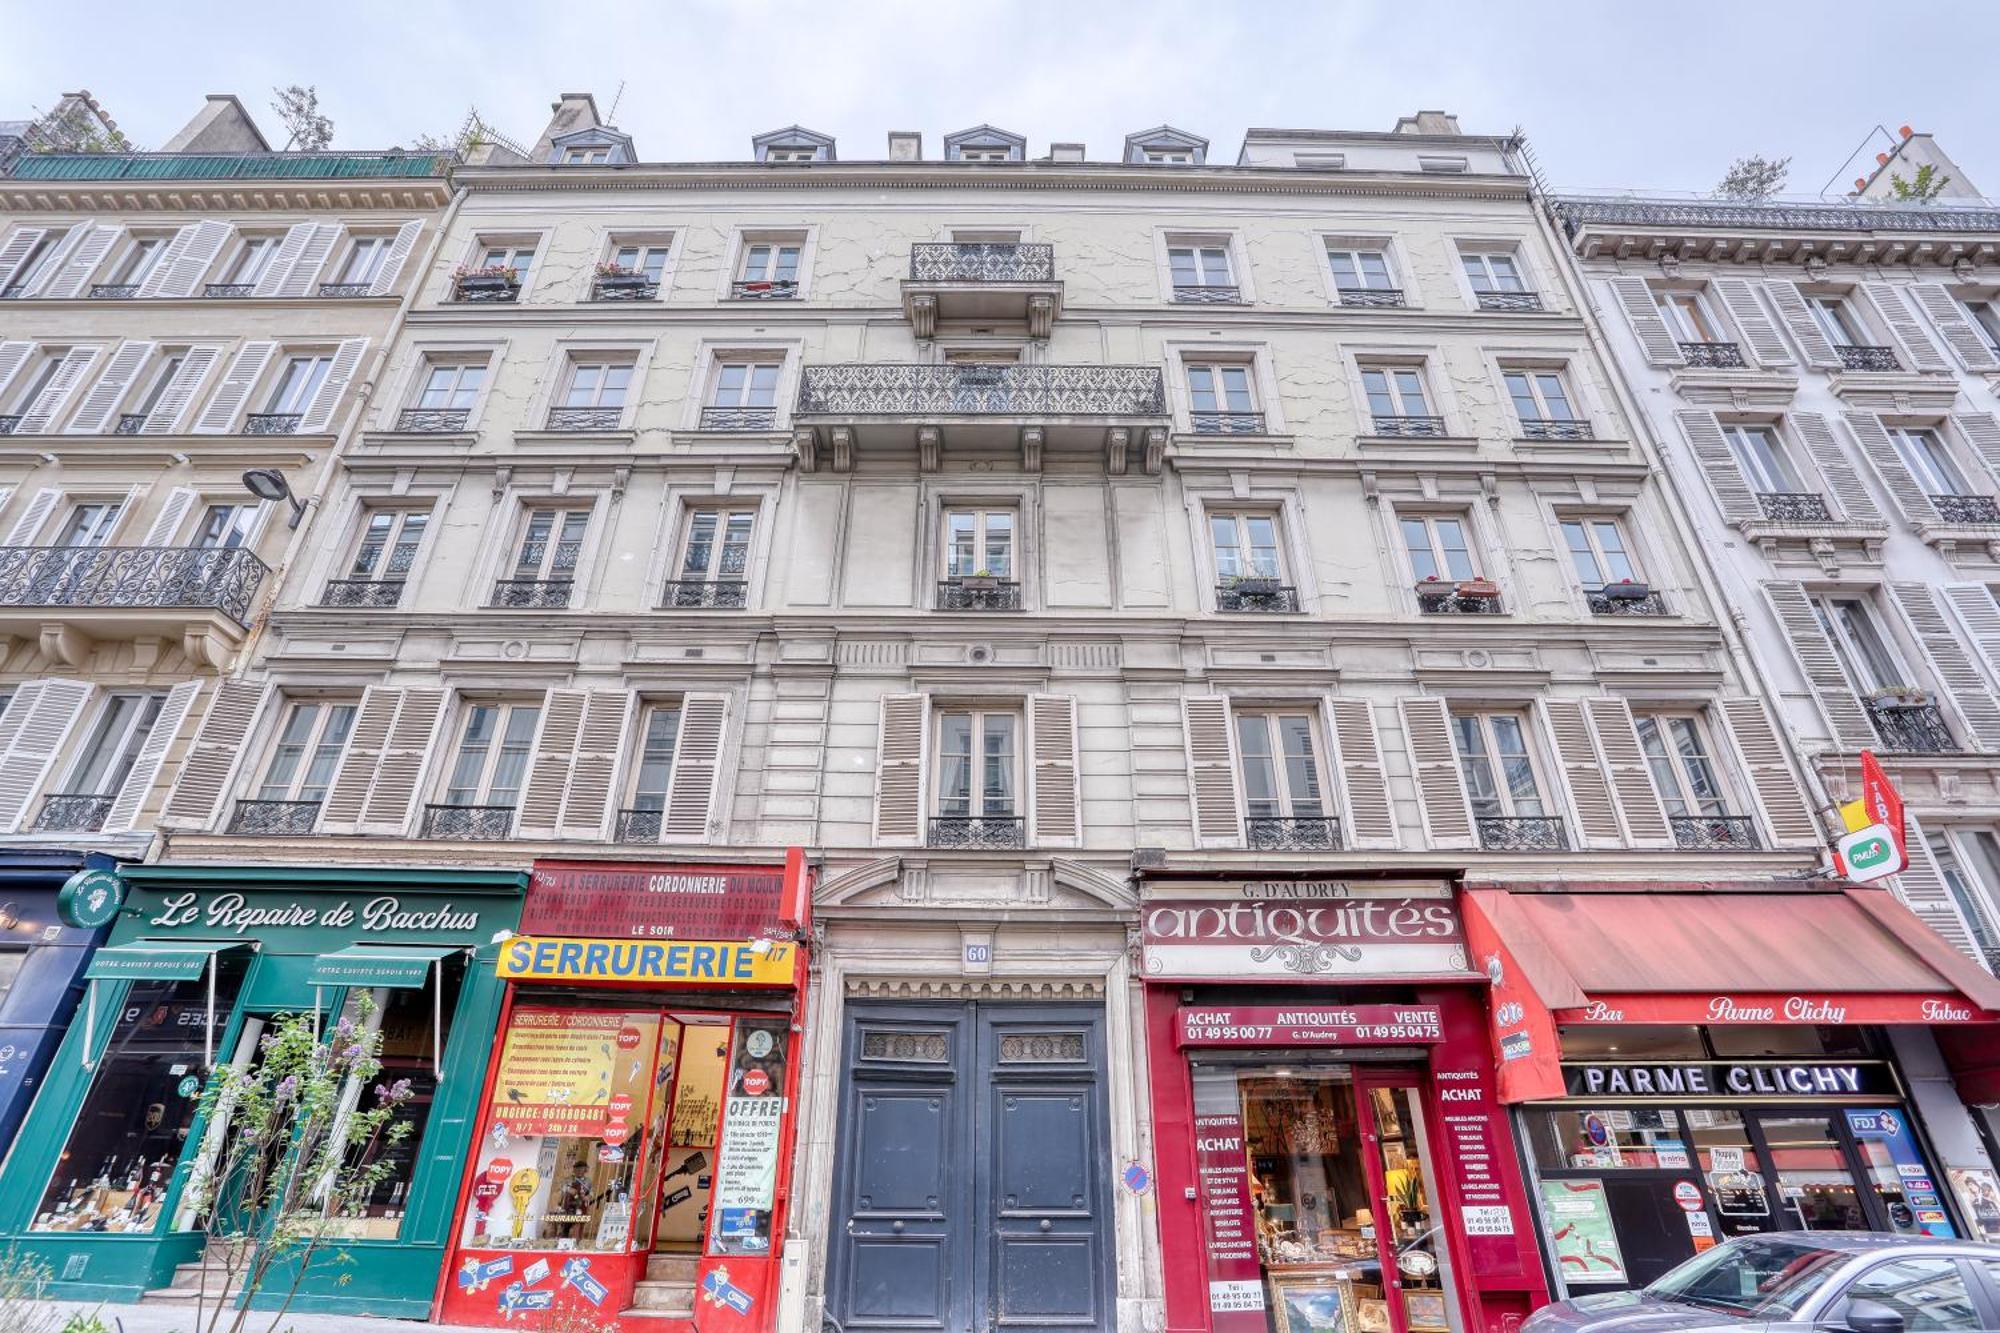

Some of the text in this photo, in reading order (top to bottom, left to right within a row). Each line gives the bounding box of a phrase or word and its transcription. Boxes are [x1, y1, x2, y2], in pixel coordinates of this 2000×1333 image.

[1871, 781, 1889, 826] TAB
[579, 875, 645, 892] SERRURERIE
[649, 875, 727, 894] CORDONNERIE
[1242, 883, 1352, 898] G. D'AUDREY
[151, 892, 199, 926] Le
[206, 893, 317, 933] Repaire
[320, 901, 354, 927] de
[362, 897, 480, 931] Bacchus
[632, 925, 644, 935] LE
[650, 926, 674, 936] SOIR
[508, 942, 753, 977] SERRURERIE
[968, 947, 986, 961] 60
[1584, 996, 1971, 1024] Bar Parme Clichy Tabac
[515, 1014, 560, 1026] SERRURERIE
[566, 1015, 622, 1027] CORDONNERIE
[1187, 1011, 1437, 1026] ACHAT ANTIQUITÉS VENTE
[1188, 1027, 1272, 1039] 01 49 95 00 77
[1302, 1031, 1337, 1040] D'Audrey
[1356, 1026, 1439, 1038] 01 49 95 04 75
[745, 1078, 767, 1086] TOPY
[1584, 1067, 1859, 1093] PARME CLICHY
[1441, 1089, 1481, 1101] ACHAT
[611, 1103, 631, 1111] TOPY
[730, 1101, 779, 1116] OFFRE
[1853, 1117, 1877, 1129] FDJ
[605, 1129, 627, 1137] TOPY
[1197, 1138, 1240, 1151] ACHAT
[490, 1165, 511, 1173] TOPY
[540, 1214, 591, 1222] ASSURANCES
